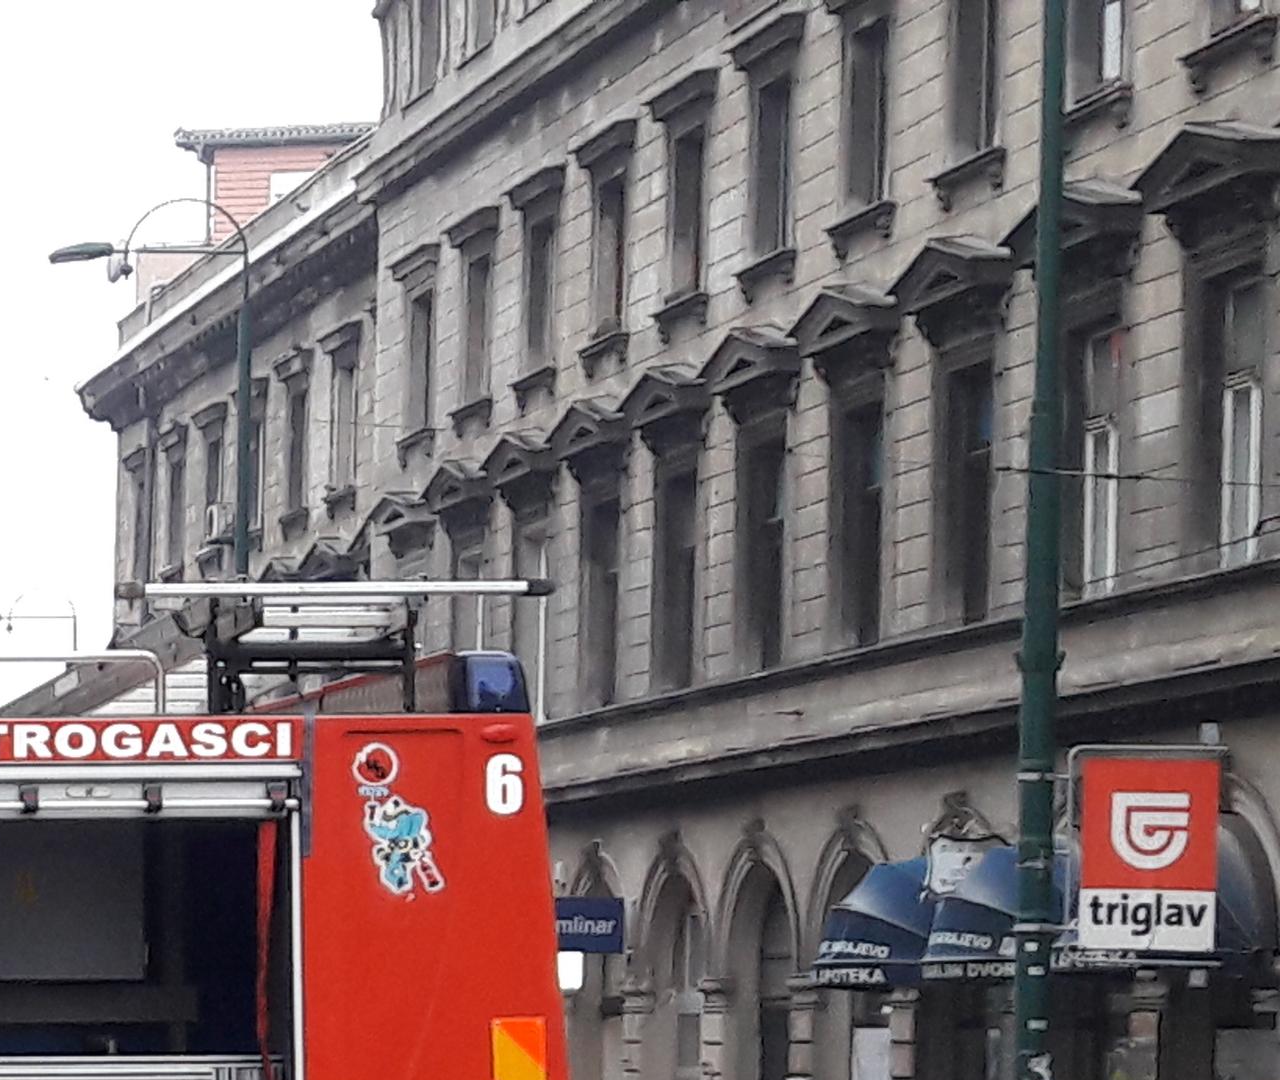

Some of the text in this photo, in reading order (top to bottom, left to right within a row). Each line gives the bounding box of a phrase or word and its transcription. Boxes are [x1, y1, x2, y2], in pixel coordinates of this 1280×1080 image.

[485, 753, 524, 815] 6
[556, 914, 617, 935] mlinar
[1090, 893, 1208, 936] triglav
